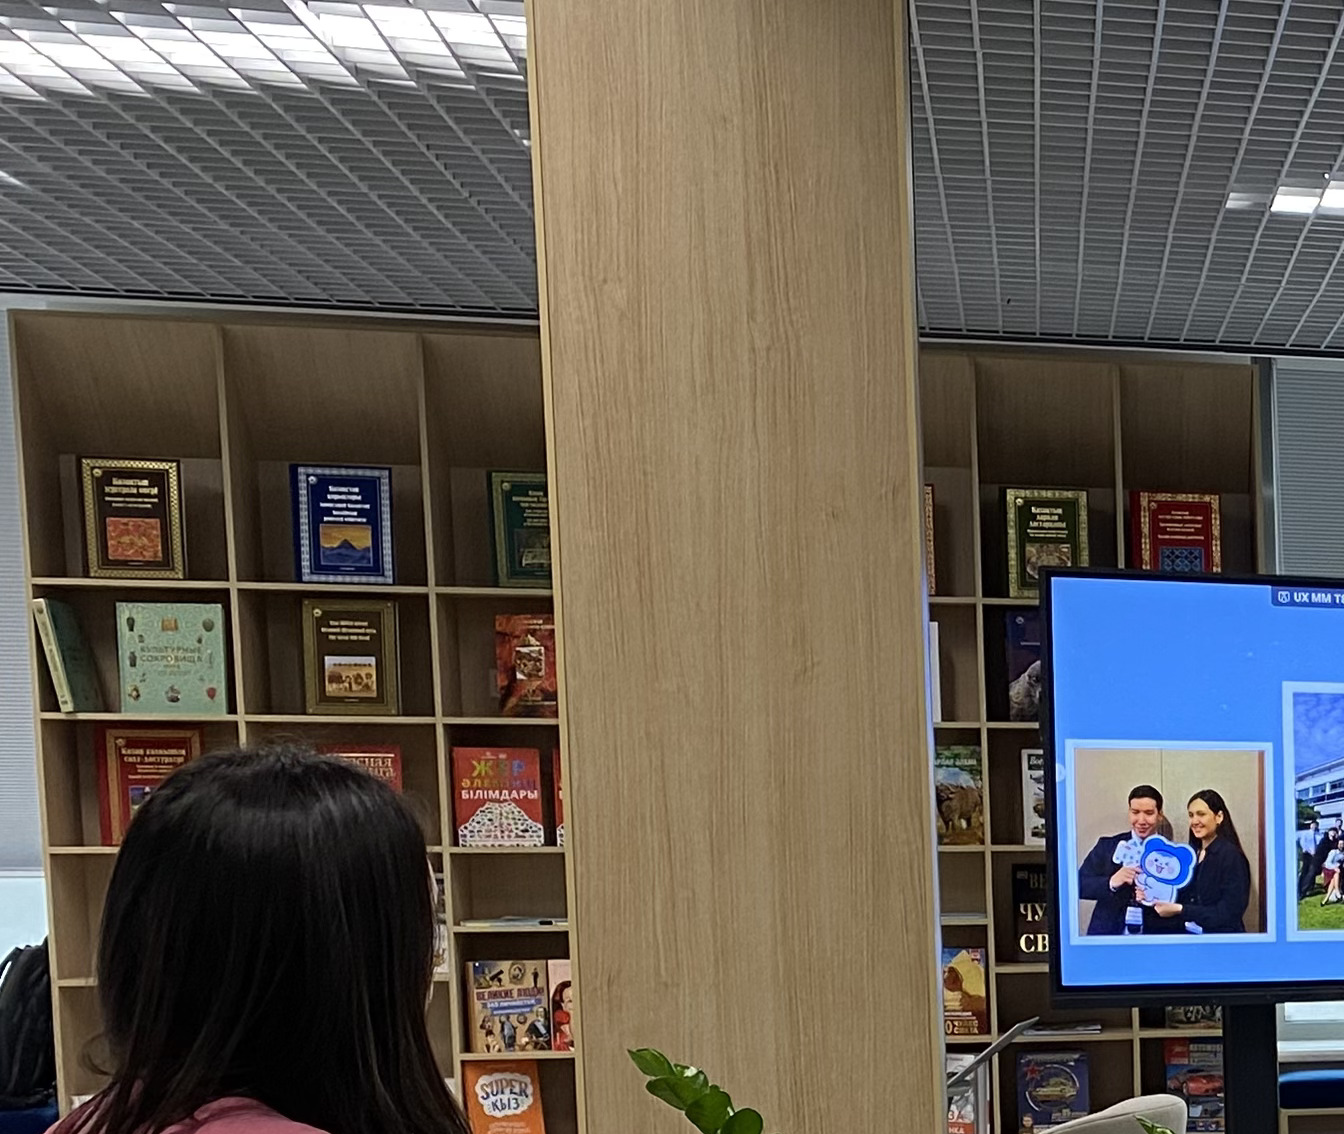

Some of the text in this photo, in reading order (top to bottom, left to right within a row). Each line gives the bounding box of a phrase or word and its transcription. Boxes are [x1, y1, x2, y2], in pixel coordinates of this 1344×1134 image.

[1293, 591, 1310, 603] UX
[1311, 592, 1332, 604] MM
[461, 789, 538, 801] БІЛІМДАРЫ
[480, 1078, 529, 1100] SUPER
